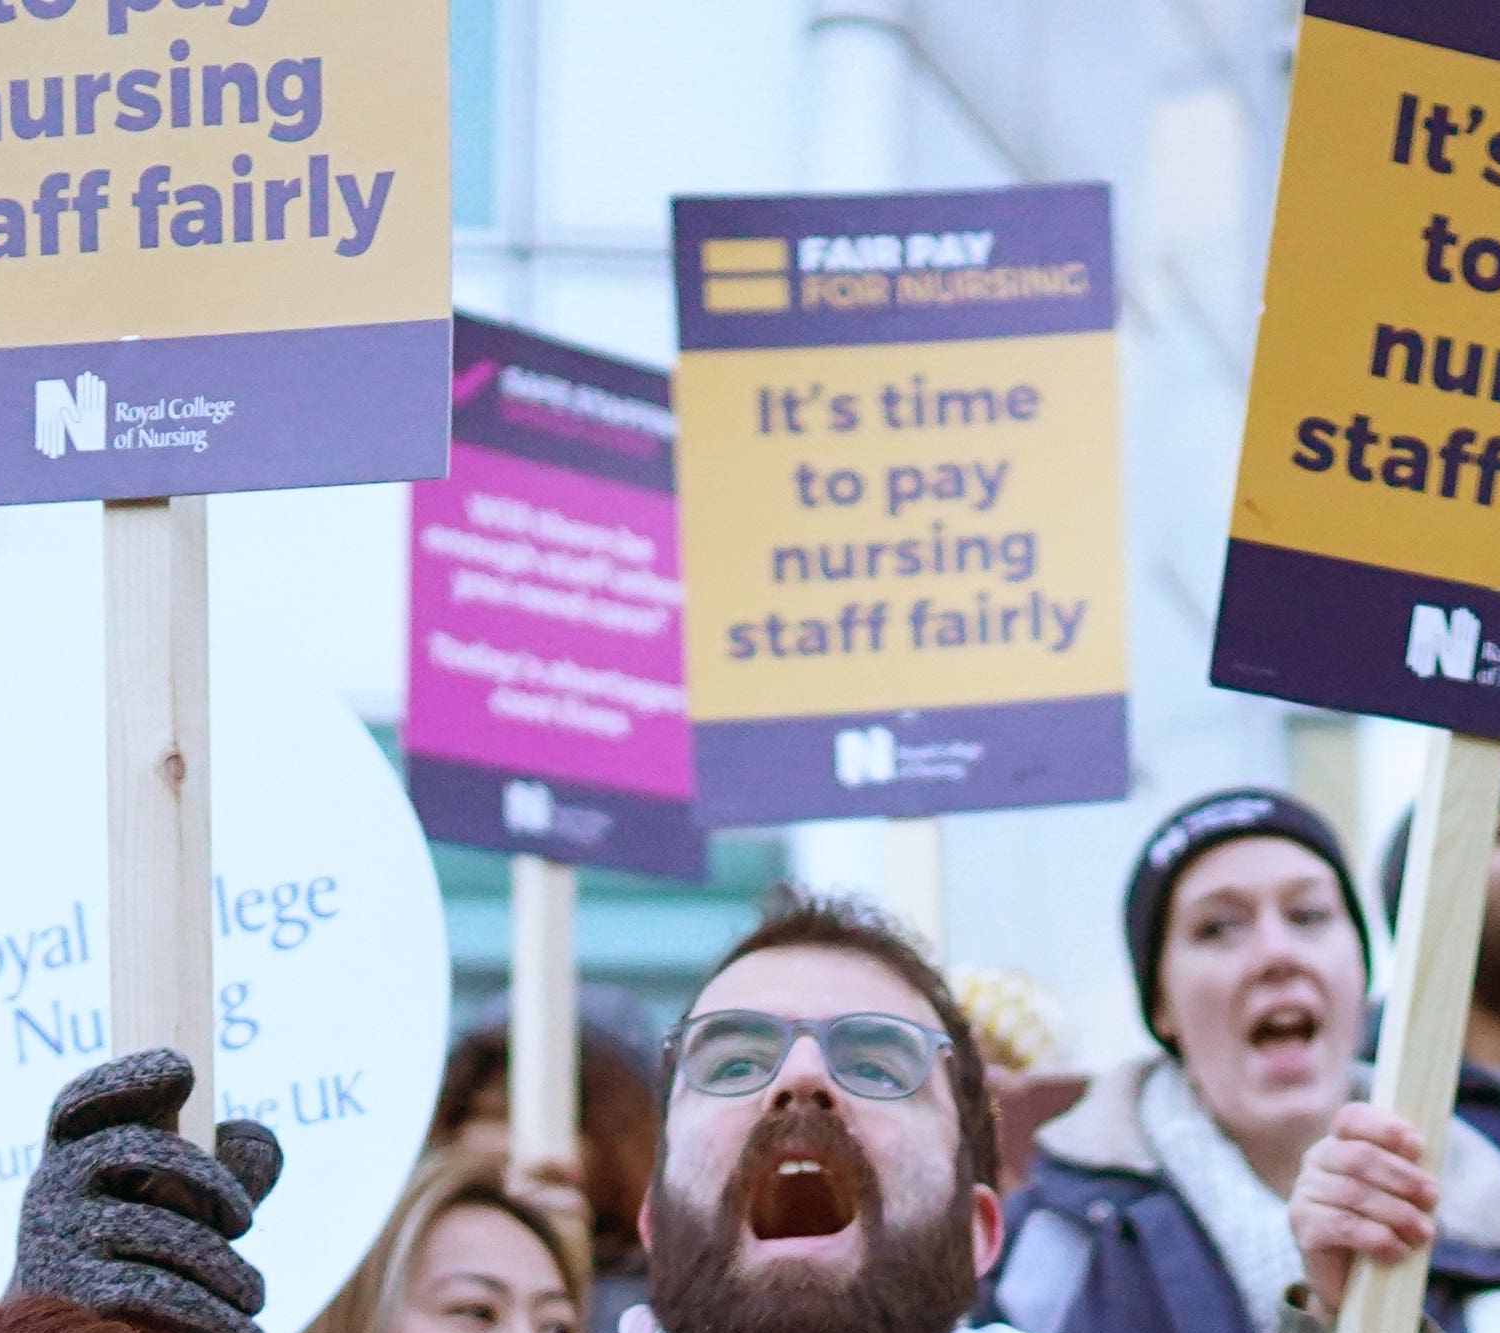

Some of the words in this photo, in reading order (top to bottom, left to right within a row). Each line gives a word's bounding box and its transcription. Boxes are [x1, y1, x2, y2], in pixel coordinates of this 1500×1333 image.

[134, 154, 395, 258] fairly
[798, 234, 900, 272] FAIR
[904, 231, 994, 268] PAY
[115, 398, 165, 428] Royal
[168, 396, 236, 424] College
[879, 373, 1040, 431] time
[114, 427, 135, 450] of
[138, 426, 208, 453] Nursing
[793, 462, 865, 508] to
[884, 459, 1011, 517] pay
[771, 522, 1038, 585] nursing
[727, 601, 888, 660] staff
[909, 593, 1088, 654] fairly
[291, 1071, 367, 1125] UK
